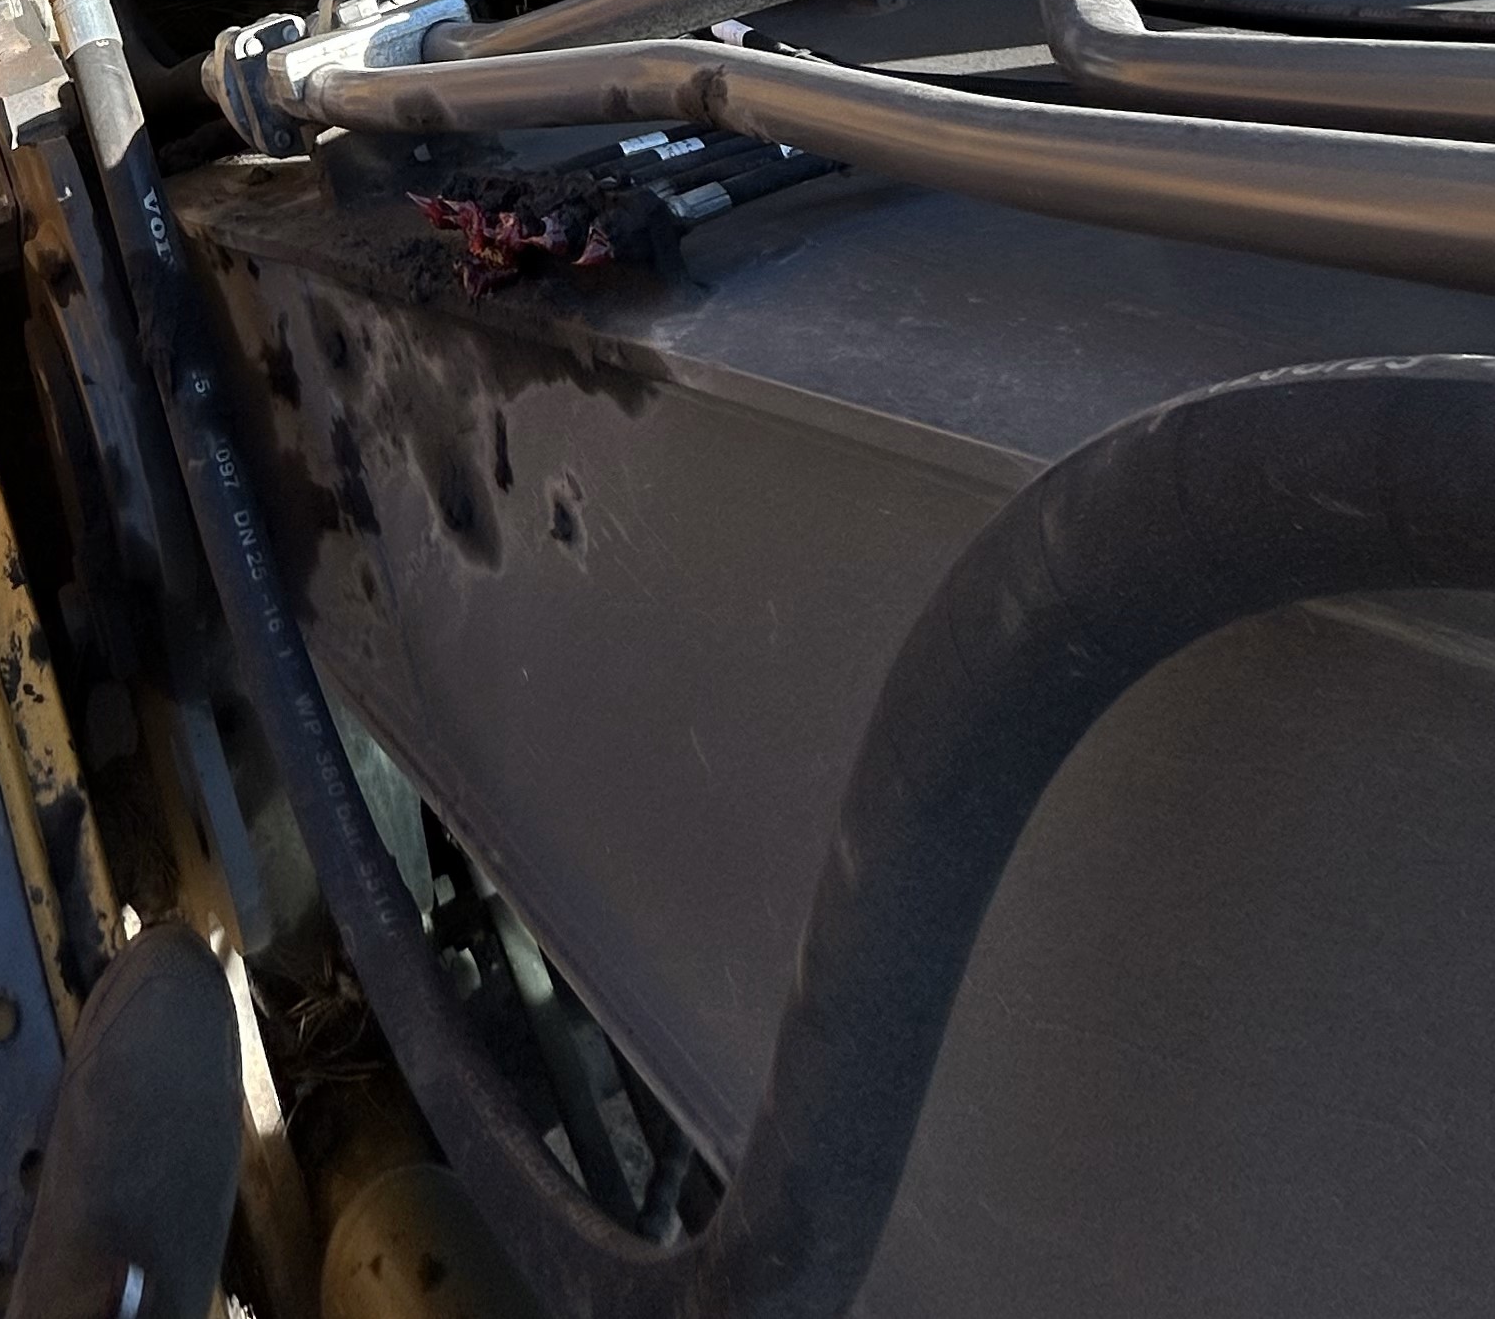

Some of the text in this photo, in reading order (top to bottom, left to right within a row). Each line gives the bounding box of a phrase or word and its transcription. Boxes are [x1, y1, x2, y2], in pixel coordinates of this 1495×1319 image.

[233, 511, 257, 547] DN
[246, 551, 267, 581] 25
[294, 692, 322, 737] WP
